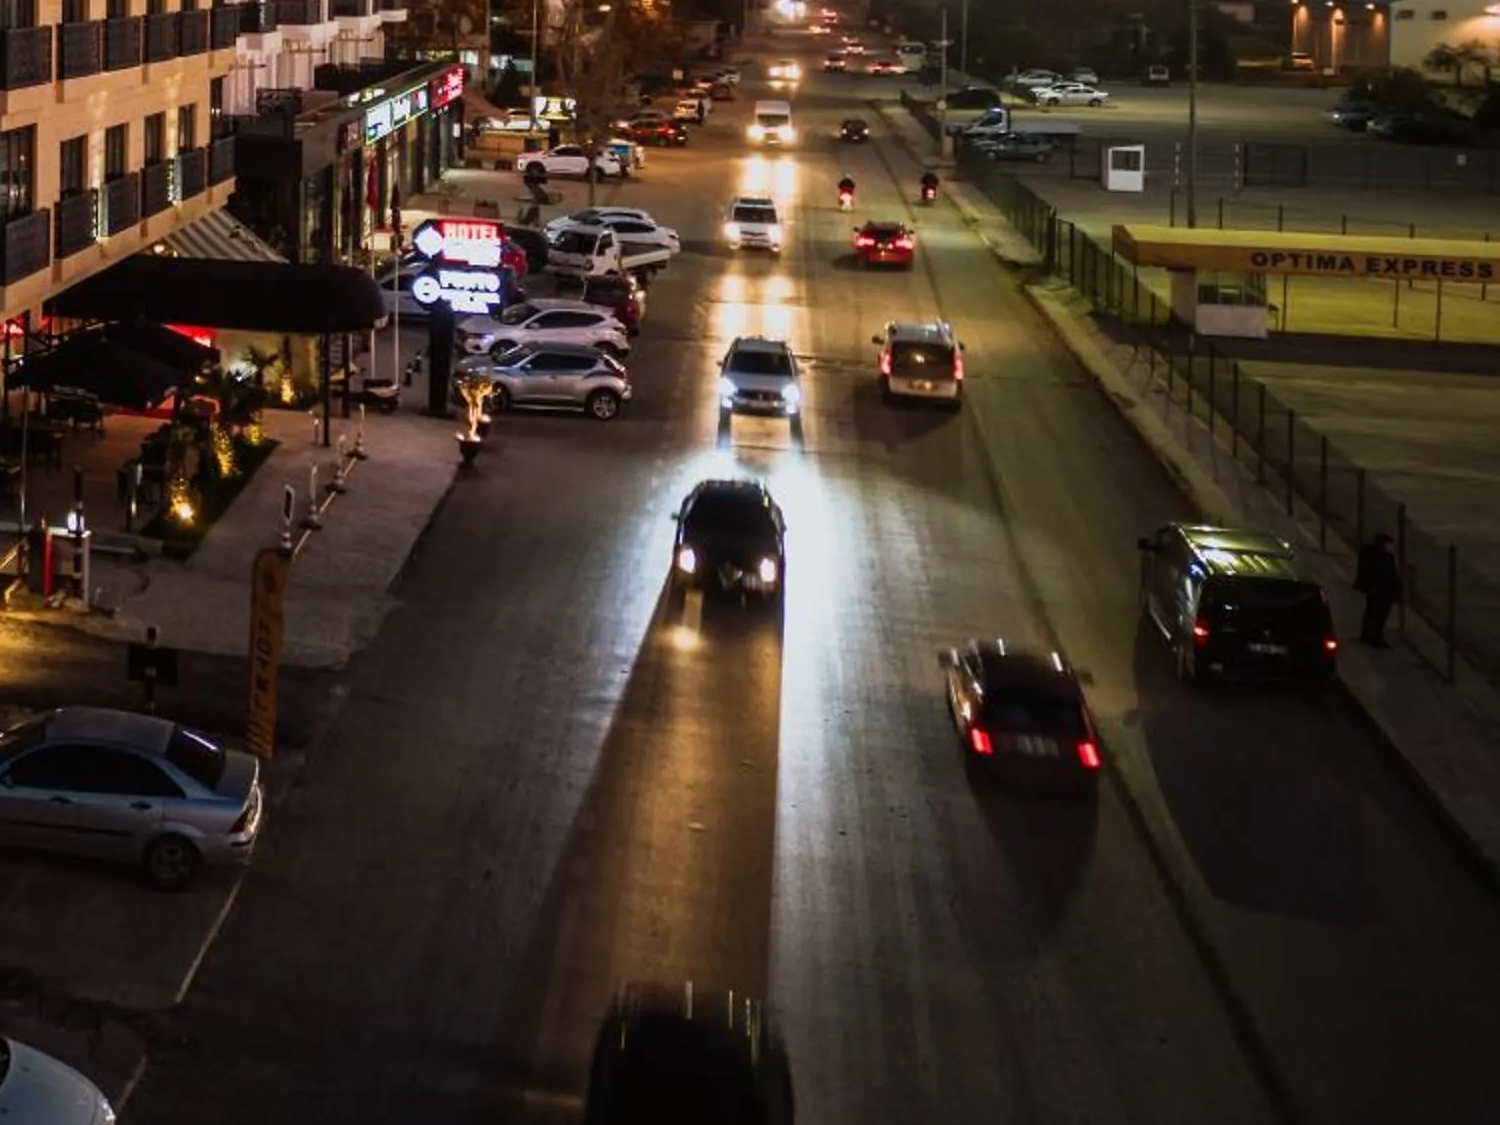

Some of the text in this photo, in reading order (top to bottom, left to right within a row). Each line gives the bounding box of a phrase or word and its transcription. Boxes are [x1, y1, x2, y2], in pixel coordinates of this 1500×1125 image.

[443, 222, 500, 241] HOTEL
[1251, 251, 1493, 278] OPTIMA EXPRESS
